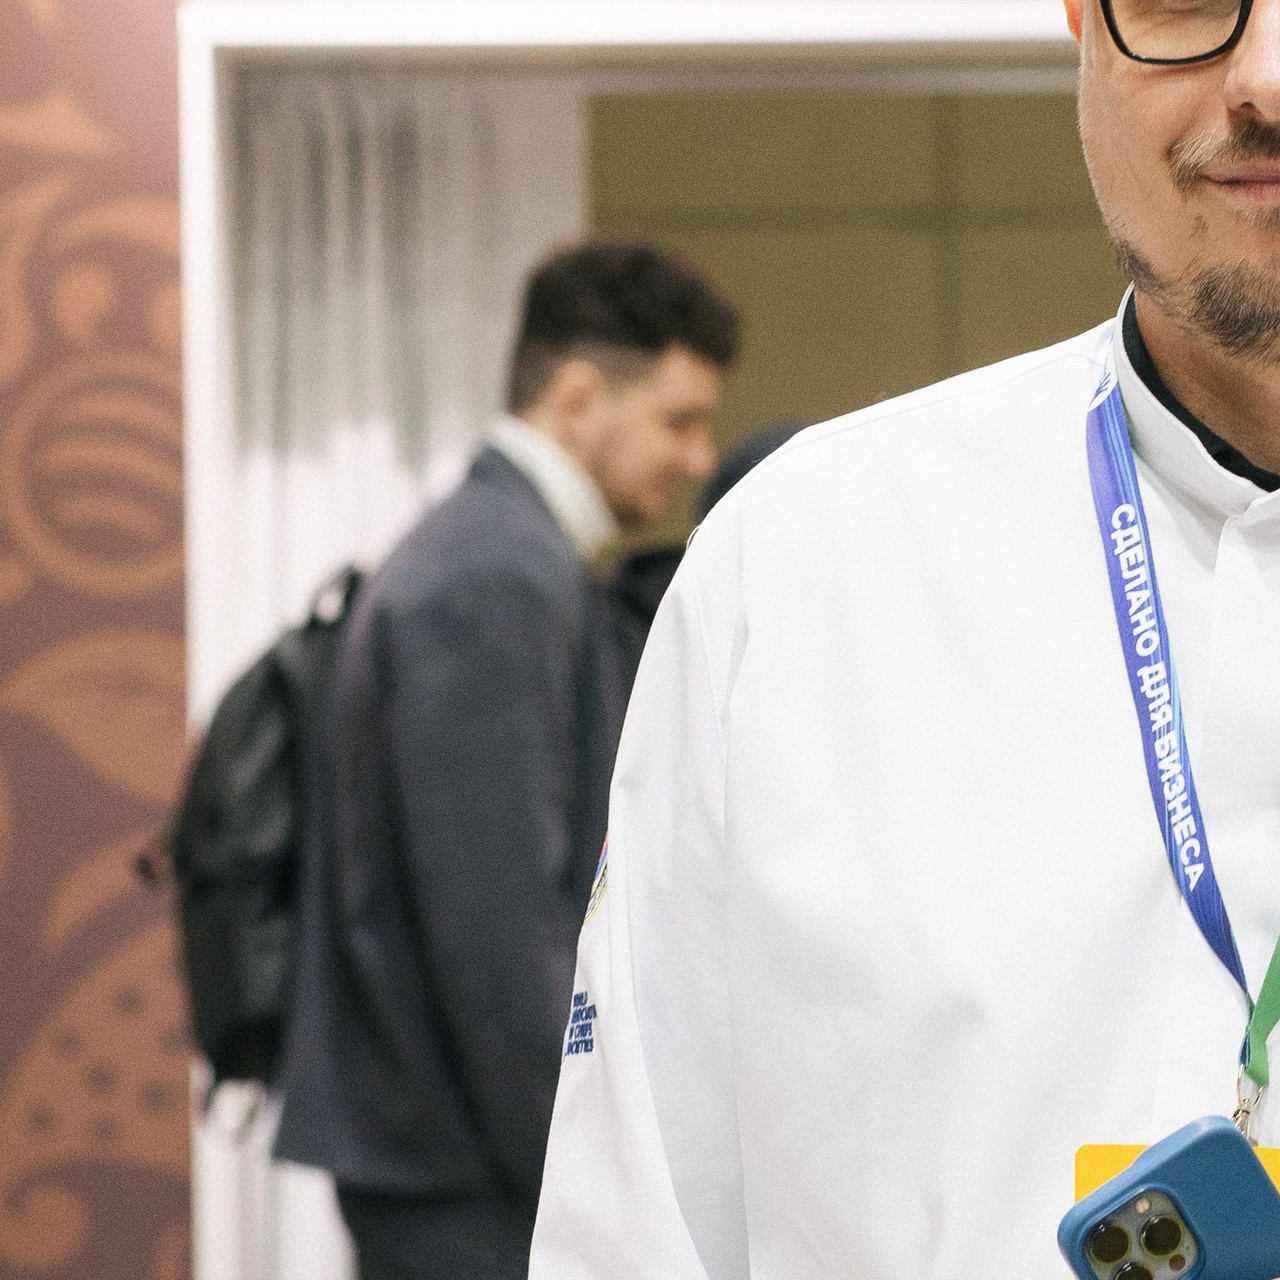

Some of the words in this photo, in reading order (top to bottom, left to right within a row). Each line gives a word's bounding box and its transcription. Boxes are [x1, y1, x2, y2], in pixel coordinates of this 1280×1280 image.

[1110, 503, 1160, 658] СДЕЛАНО
[1136, 660, 1173, 733] ДЛЯ
[1153, 732, 1206, 893] БИЗНЕСА
